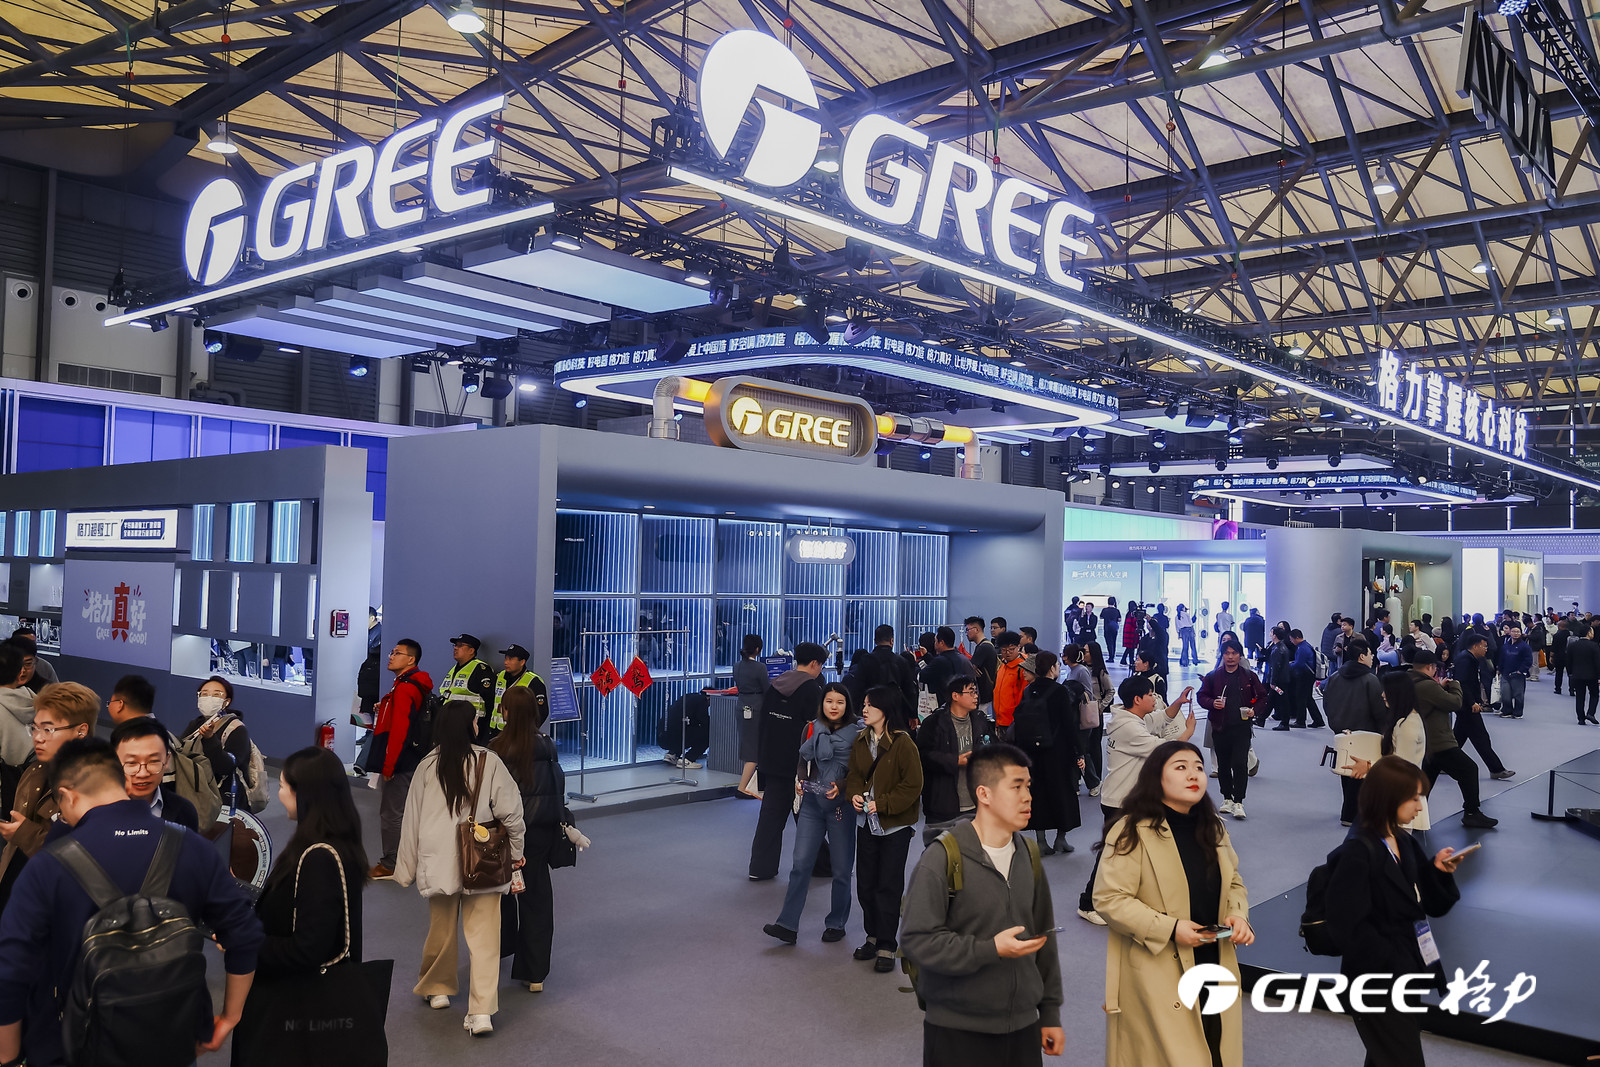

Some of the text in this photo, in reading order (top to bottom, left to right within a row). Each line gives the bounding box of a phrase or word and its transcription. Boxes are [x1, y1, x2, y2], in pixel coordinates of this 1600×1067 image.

[255, 95, 508, 262] GREE
[840, 113, 1095, 292] GREE
[609, 352, 630, 366] 格力造
[728, 336, 756, 351] 好空调
[757, 333, 786, 347] 格力造
[884, 337, 906, 354] 好电器
[905, 342, 926, 360] 格力造
[927, 348, 952, 365] 格力真好
[1378, 348, 1528, 460] 格力掌握核心科技
[768, 409, 851, 448] GREE
[82, 581, 146, 642] 格力真好
[96, 626, 110, 640] GREE
[114, 829, 149, 837] No Limits
[309, 1017, 354, 1031] LIMITS
